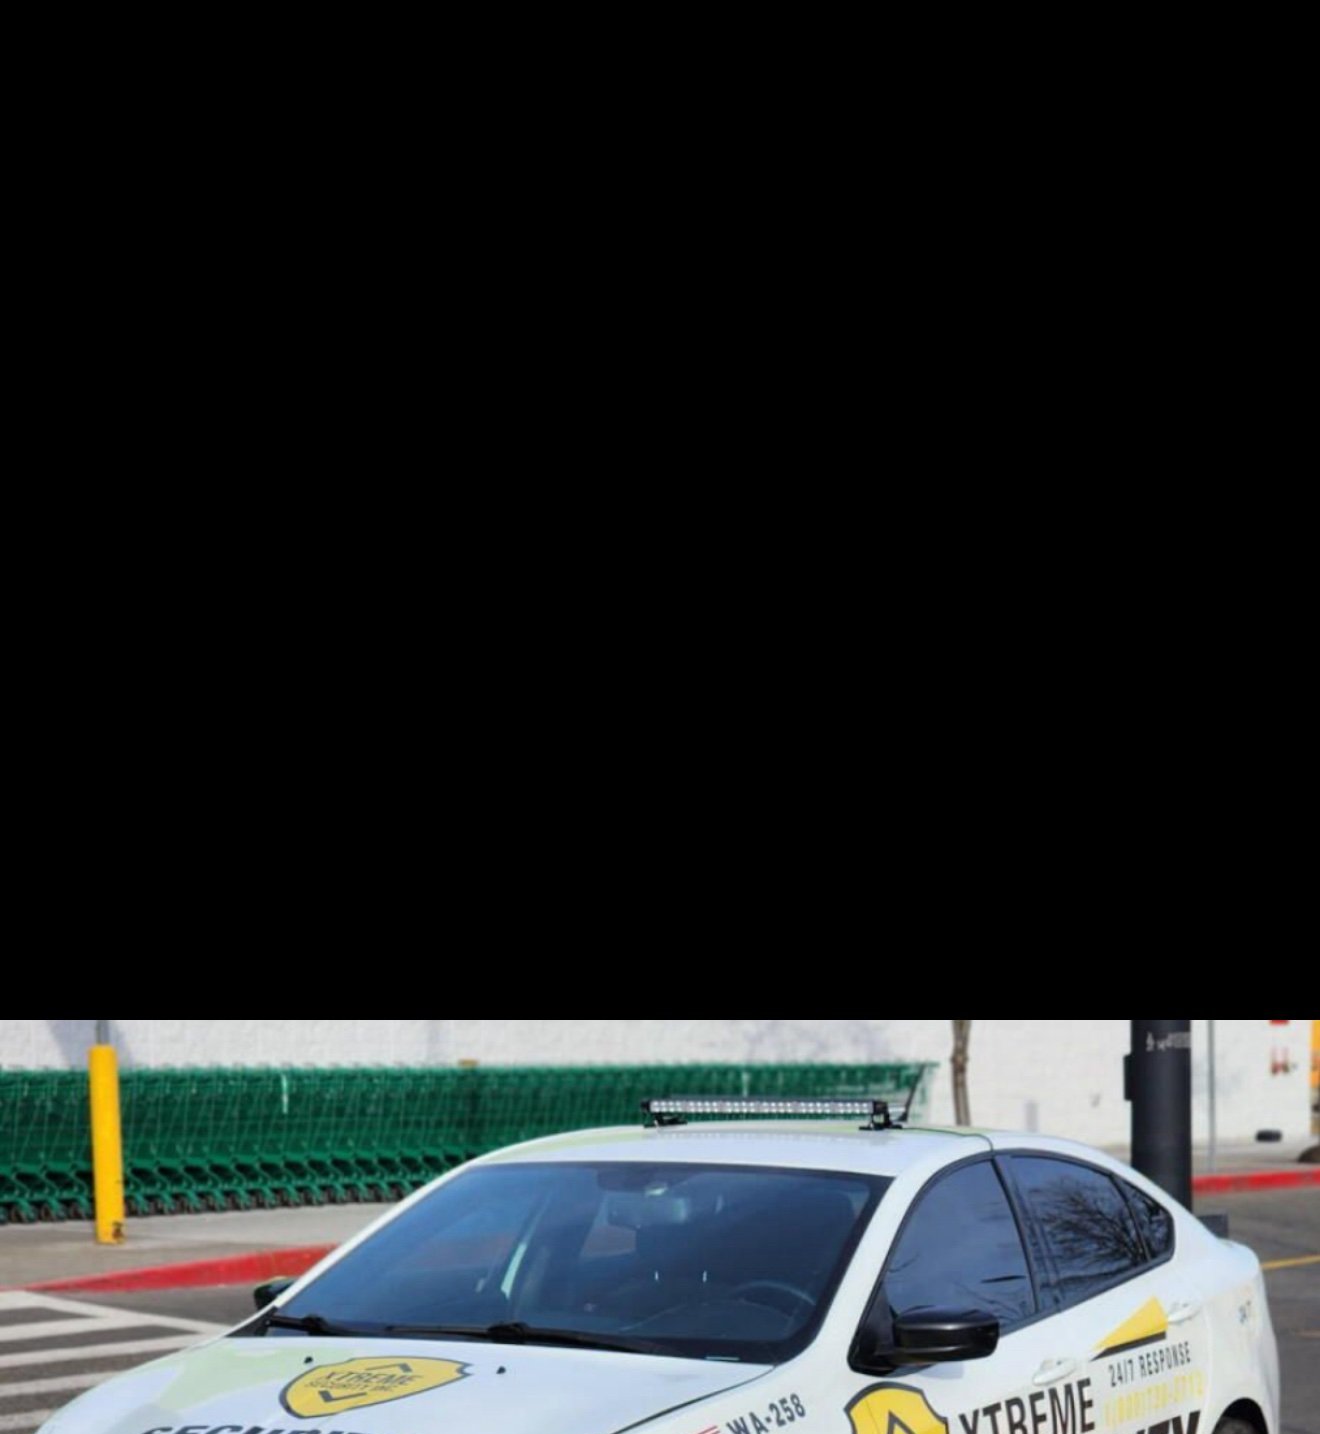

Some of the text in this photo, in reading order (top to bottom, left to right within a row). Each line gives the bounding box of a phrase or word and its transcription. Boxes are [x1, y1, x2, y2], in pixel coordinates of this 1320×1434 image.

[323, 1371, 422, 1386] XTREME
[1108, 1341, 1191, 1388] 24/7 RESPONSE
